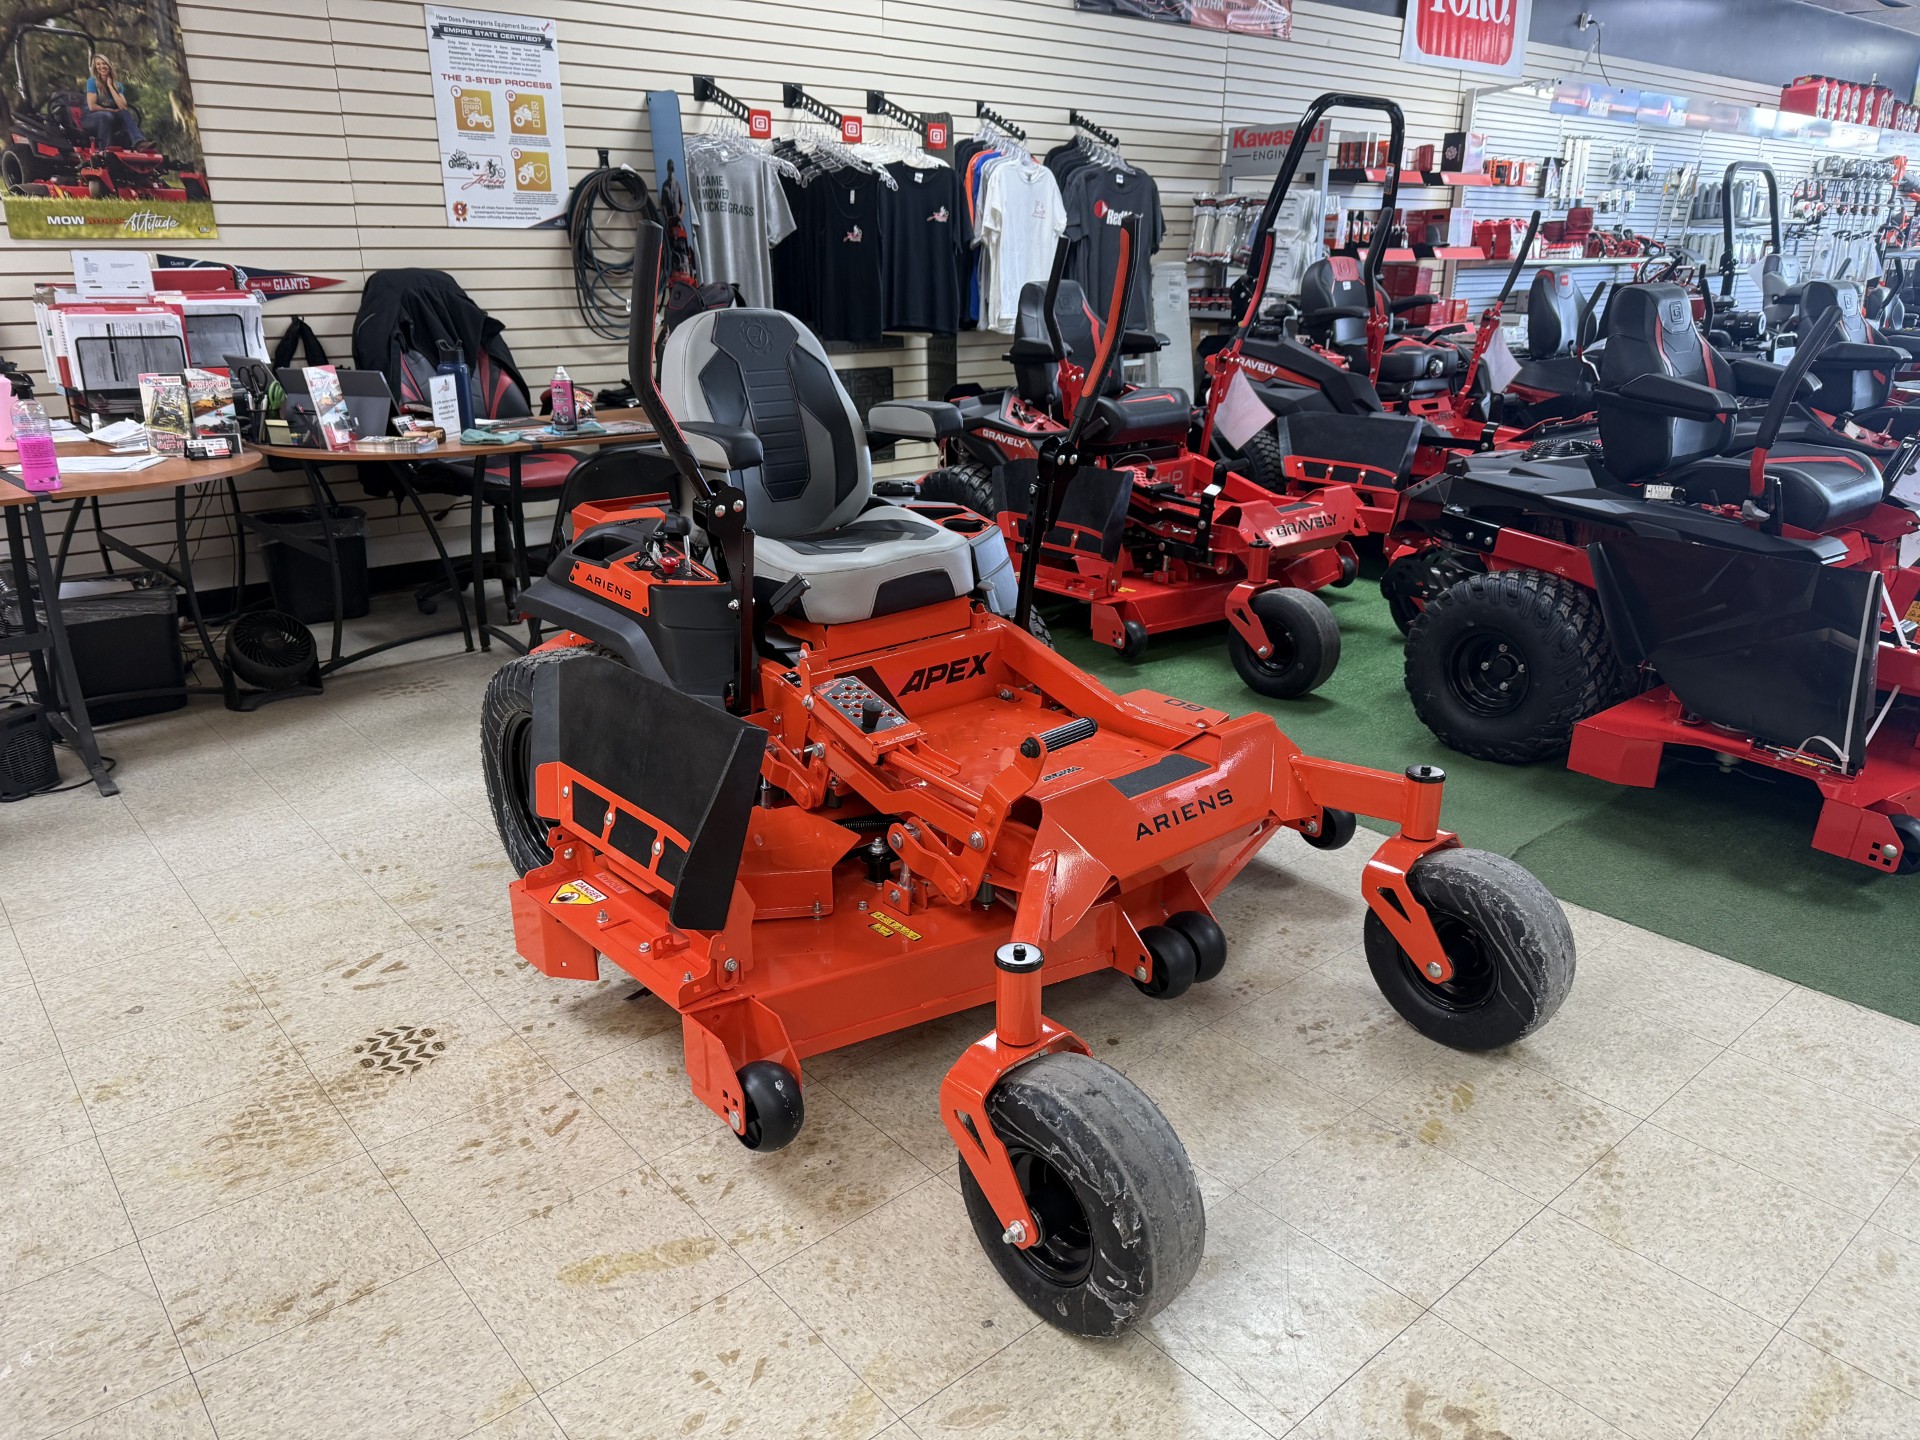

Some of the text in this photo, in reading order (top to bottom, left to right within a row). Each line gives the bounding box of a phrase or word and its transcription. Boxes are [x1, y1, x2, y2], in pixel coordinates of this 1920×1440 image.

[462, 17, 493, 26] Powersports
[494, 20, 520, 30] Equipment
[444, 26, 542, 42] EMPIRE STATE CERTIFIED?
[441, 73, 552, 89] THE 3-STEP PROCESS
[1233, 122, 1324, 149] Kawaski
[1253, 150, 1286, 160] ENGIN
[701, 176, 723, 187] CAME
[703, 189, 729, 200] MOWED
[704, 201, 727, 212] KICKED
[728, 202, 754, 216] GRASS
[47, 216, 84, 224] MOW
[124, 209, 179, 232] Attitude
[273, 278, 310, 290] GIANTS
[1239, 356, 1278, 374] RAVELY
[983, 429, 1026, 448] GRAVELY
[1275, 513, 1337, 537] GRAVELY
[586, 574, 632, 600] ARIENS
[897, 651, 992, 697] APEX
[1136, 788, 1233, 841] ARIENS
[575, 882, 602, 899] DANGER
